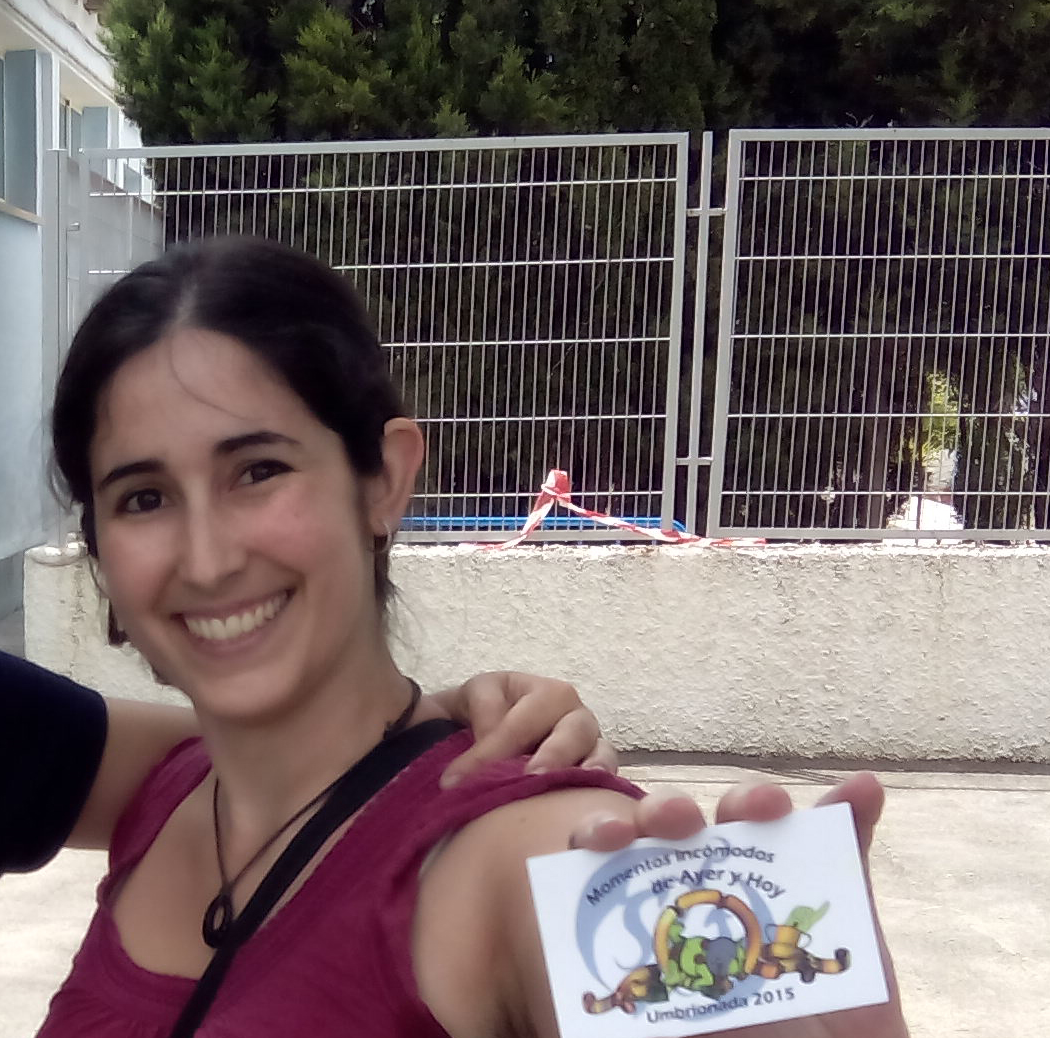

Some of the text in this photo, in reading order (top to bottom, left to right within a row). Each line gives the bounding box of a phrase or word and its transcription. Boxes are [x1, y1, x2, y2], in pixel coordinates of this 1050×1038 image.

[586, 854, 671, 906] Momentos
[650, 867, 786, 899] de Ayer y Hoy
[646, 987, 796, 1024] Umbrionada 2015
